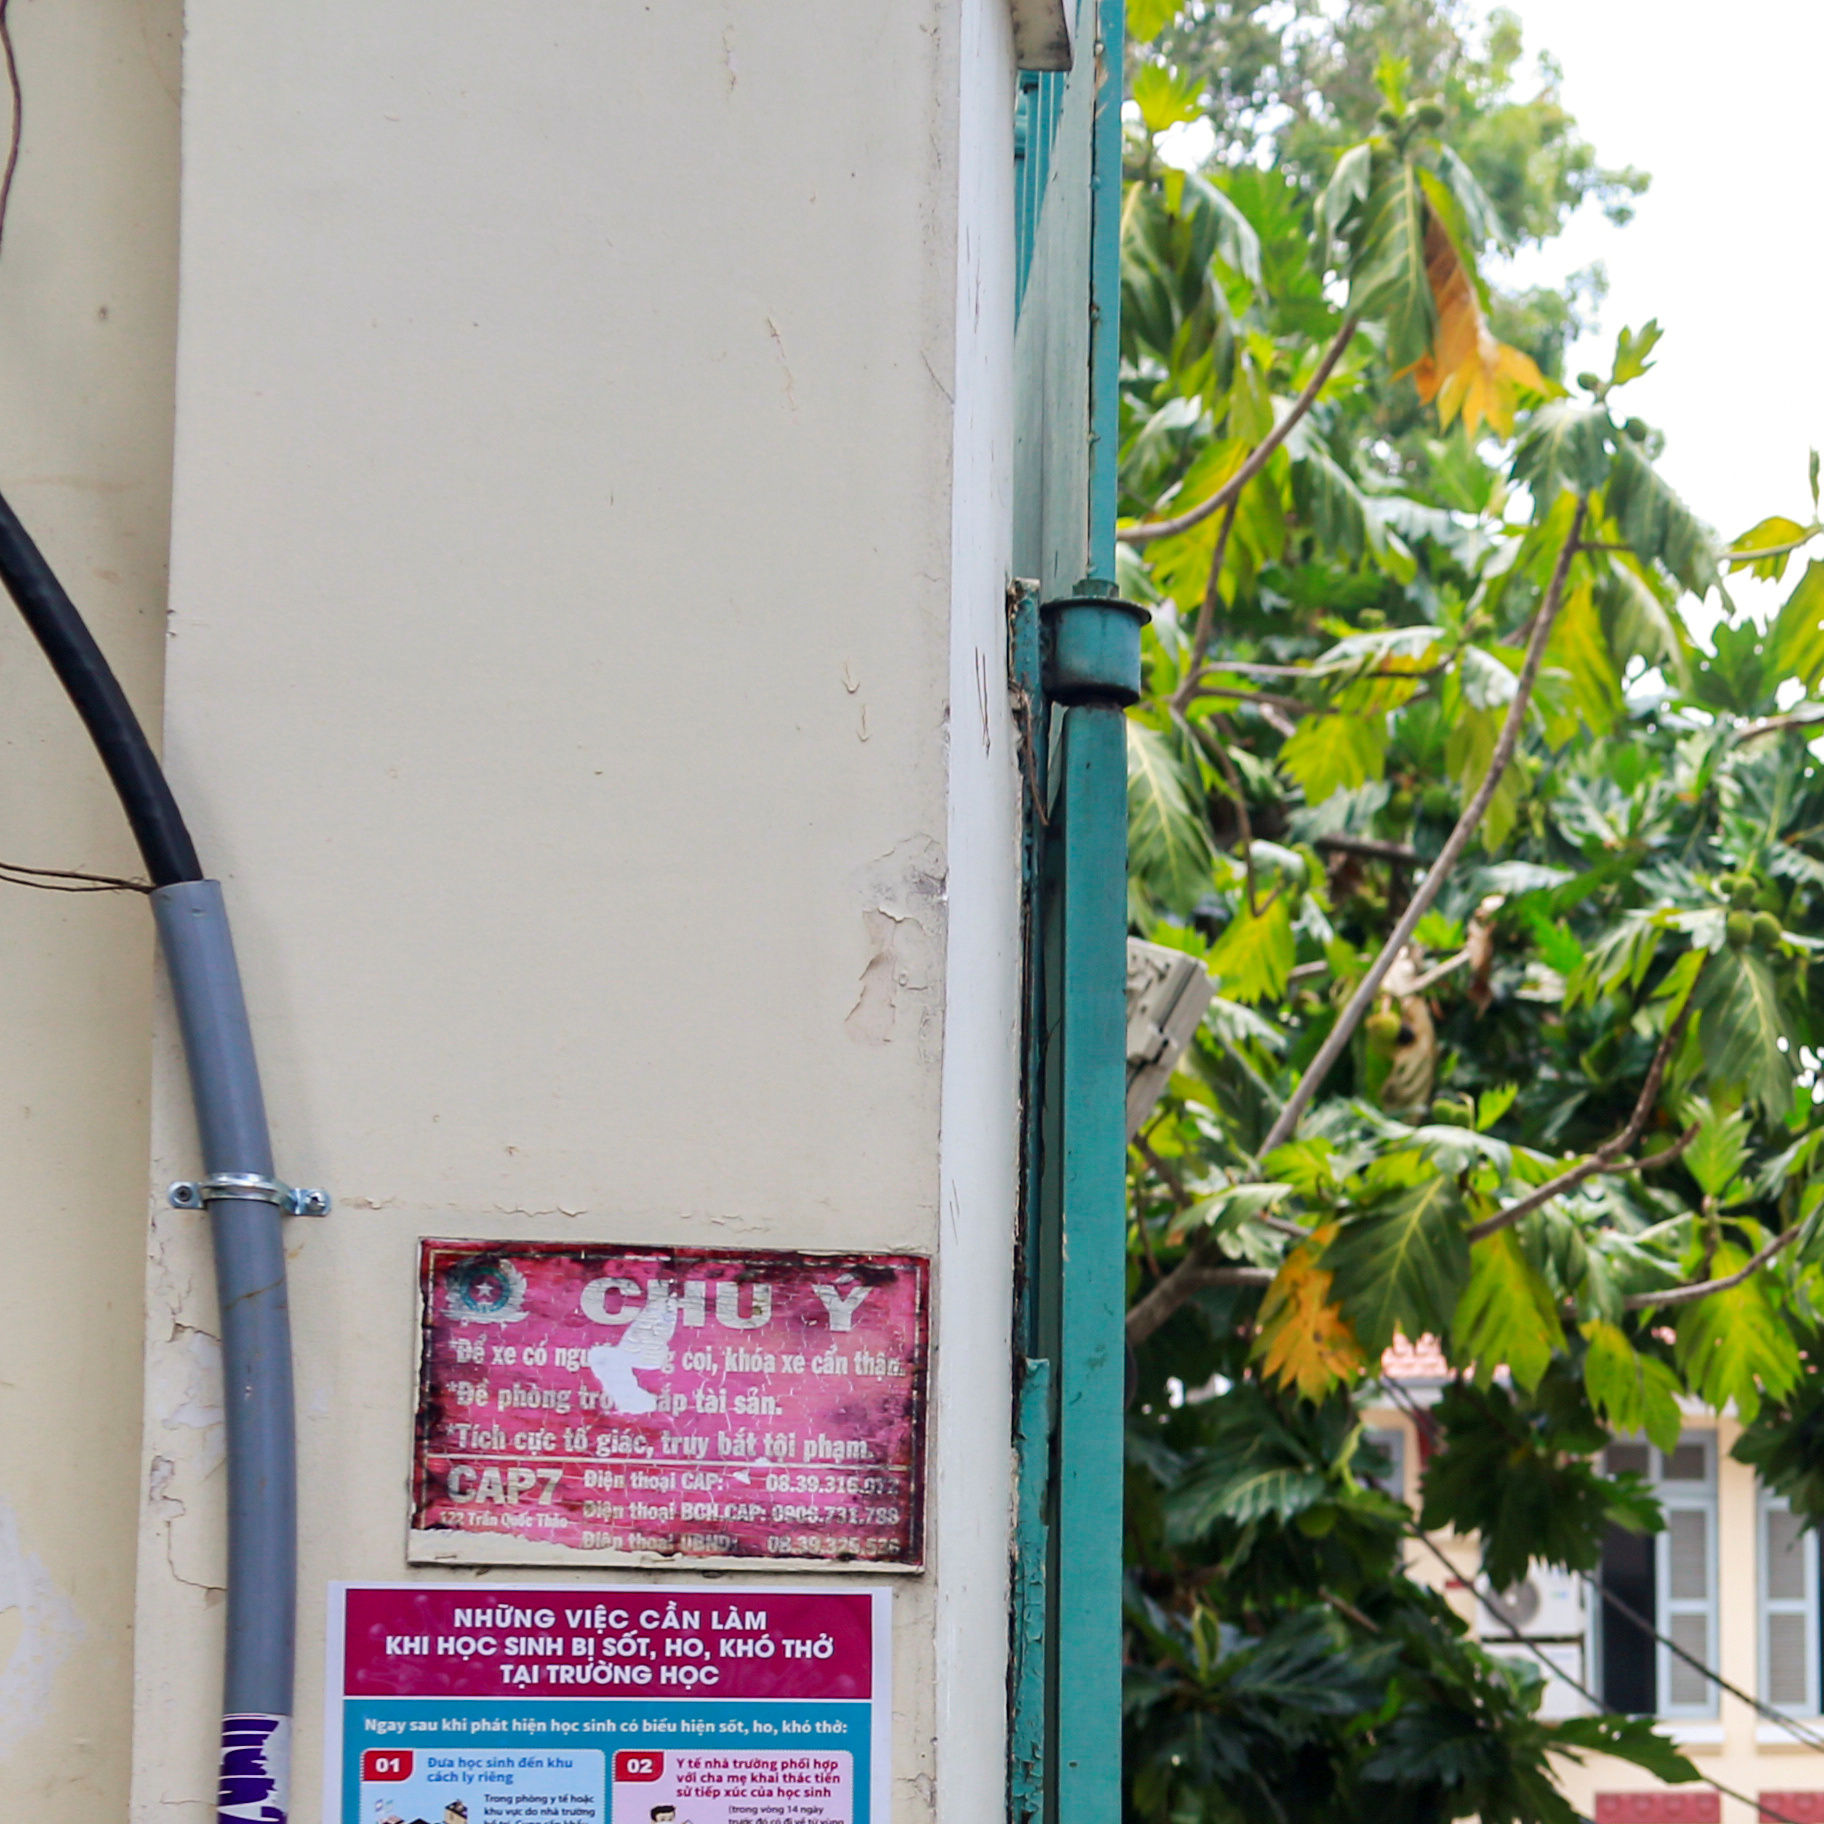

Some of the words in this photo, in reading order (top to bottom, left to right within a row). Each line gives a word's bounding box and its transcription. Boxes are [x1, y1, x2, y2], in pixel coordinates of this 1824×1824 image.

[812, 1273, 874, 1332] Ý
[492, 1346, 517, 1367] xe
[522, 1334, 548, 1367] có
[681, 1345, 718, 1377] coi,
[725, 1346, 776, 1374] khóa
[781, 1353, 806, 1375] xe
[811, 1343, 849, 1375] cẩn
[497, 1381, 572, 1413] phòng
[578, 1384, 620, 1416] trộ
[656, 1382, 689, 1417] ắp
[695, 1387, 728, 1414] tài
[734, 1385, 783, 1416] sản.
[513, 1427, 557, 1456] cực
[562, 1424, 593, 1451] tố
[595, 1428, 655, 1460] giác,
[661, 1433, 708, 1460] truy
[717, 1430, 756, 1457] bắt
[764, 1432, 796, 1462] tội
[803, 1437, 874, 1465] phạm.
[446, 1464, 564, 1506] CAP7
[583, 1469, 626, 1491] Điện
[630, 1470, 677, 1493] thoại
[681, 1471, 725, 1493] CAP:
[467, 1511, 498, 1528] Trần
[501, 1511, 535, 1528] Quốc
[582, 1499, 625, 1520] Điện
[629, 1501, 677, 1525] thoại
[455, 1604, 555, 1628] NHỮNG
[565, 1602, 629, 1633] VIỆC
[639, 1601, 700, 1629] CẦN
[712, 1606, 766, 1630] LÀM
[386, 1636, 429, 1655] KHI
[438, 1637, 496, 1661] HỌC
[505, 1637, 563, 1655] SINH
[572, 1638, 594, 1661] BỊ
[598, 1632, 656, 1662] SỐT,
[666, 1639, 710, 1661] HO,
[720, 1634, 774, 1658] KHÓ
[782, 1633, 833, 1658] THỞ
[500, 1665, 538, 1688] TẠI
[547, 1660, 652, 1684] TRƯỜNG
[661, 1666, 718, 1689] HỌC
[366, 1719, 406, 1734] Ngay
[410, 1719, 437, 1734] sau
[442, 1718, 466, 1733] khi
[471, 1718, 507, 1733] phát
[513, 1718, 546, 1734] hiện
[551, 1719, 578, 1734] học
[583, 1719, 616, 1735] sinh
[621, 1720, 638, 1734] có
[643, 1719, 676, 1735] biểu
[681, 1720, 715, 1736] hiện
[720, 1720, 748, 1734] sốt,
[753, 1720, 778, 1735] ho,
[783, 1720, 811, 1735] khó
[815, 1720, 847, 1735] thở:
[374, 1757, 401, 1773] 01
[427, 1757, 455, 1768] Đưa
[458, 1756, 482, 1771] học
[486, 1756, 515, 1769] sinh
[517, 1757, 544, 1769] đến
[547, 1757, 573, 1769] khu
[626, 1758, 653, 1774] 02
[676, 1758, 685, 1769] Y
[687, 1757, 701, 1769] tế
[704, 1757, 729, 1769] nhà
[732, 1758, 778, 1773] trường
[780, 1758, 810, 1772] phối
[813, 1758, 839, 1774] hợp
[427, 1771, 459, 1783] cách
[478, 1770, 514, 1786] riêng
[676, 1772, 697, 1783] với
[700, 1772, 723, 1783] cha
[727, 1774, 747, 1786] mẹ
[750, 1772, 779, 1784] khai
[782, 1772, 811, 1784] thác
[694, 1785, 721, 1799] tiếp
[724, 1785, 747, 1797] xúc
[750, 1785, 774, 1798] của
[777, 1787, 800, 1801] học
[804, 1786, 832, 1798] sinh
